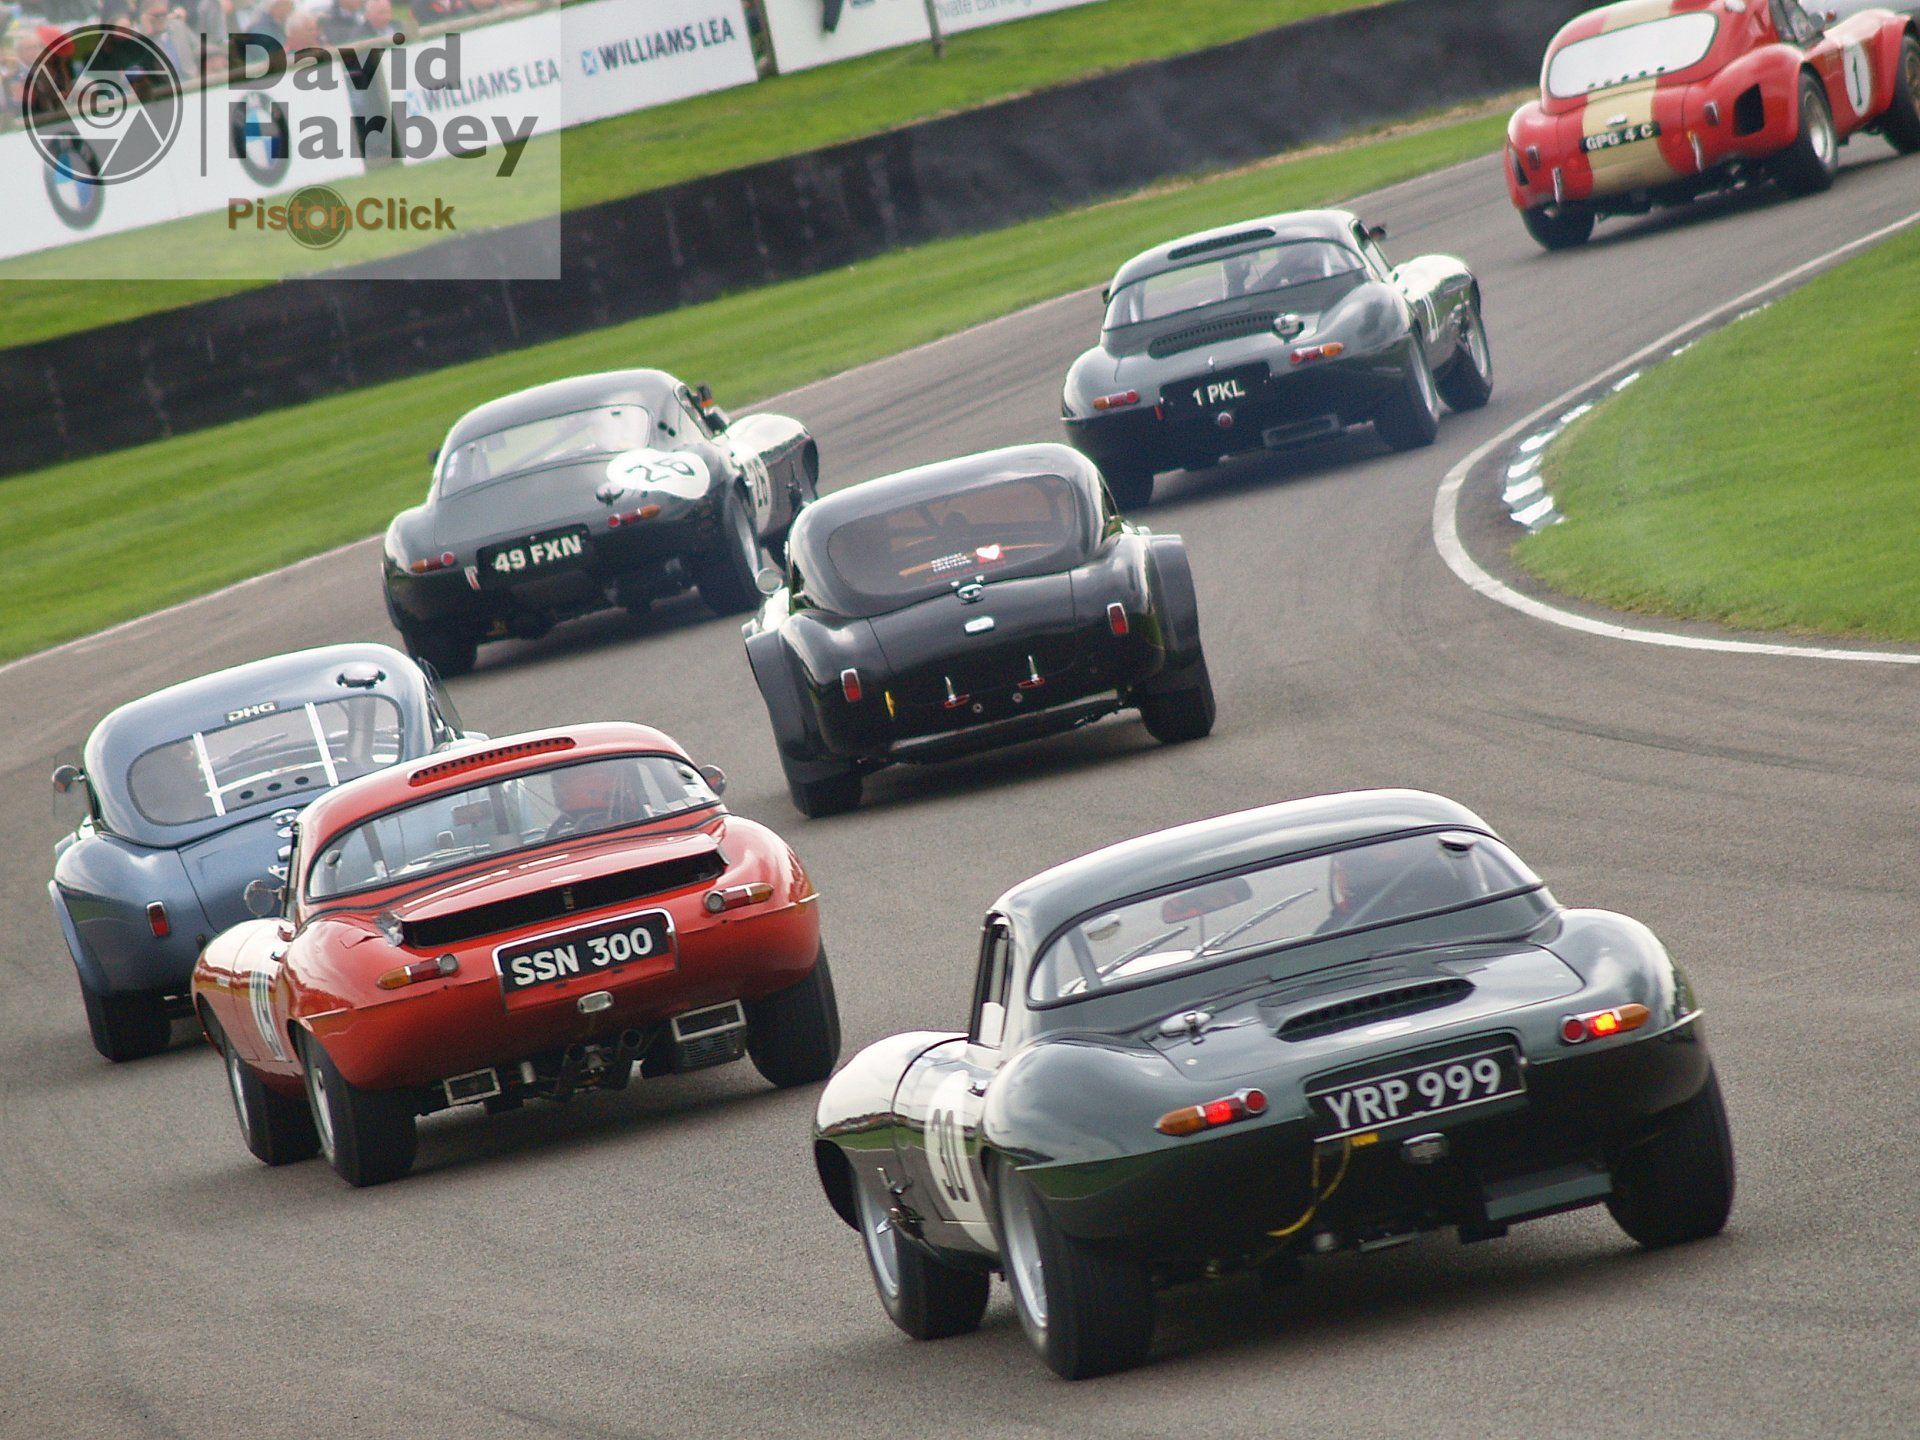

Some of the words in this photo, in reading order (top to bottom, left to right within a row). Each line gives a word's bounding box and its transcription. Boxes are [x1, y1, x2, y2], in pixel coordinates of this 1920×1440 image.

[597, 25, 698, 71] WILLIAMS
[698, 17, 736, 48] LEA
[422, 66, 522, 112] WILLIAMS
[524, 58, 561, 89] LEA
[1641, 123, 1654, 138] C
[1192, 387, 1202, 406] 1
[1207, 379, 1246, 404] PKL
[494, 551, 526, 573] 49
[529, 534, 582, 565] FXN
[511, 944, 580, 986] SSN
[587, 927, 653, 966] 300
[1325, 1079, 1410, 1129] YRP
[1417, 1058, 1501, 1107] 999
